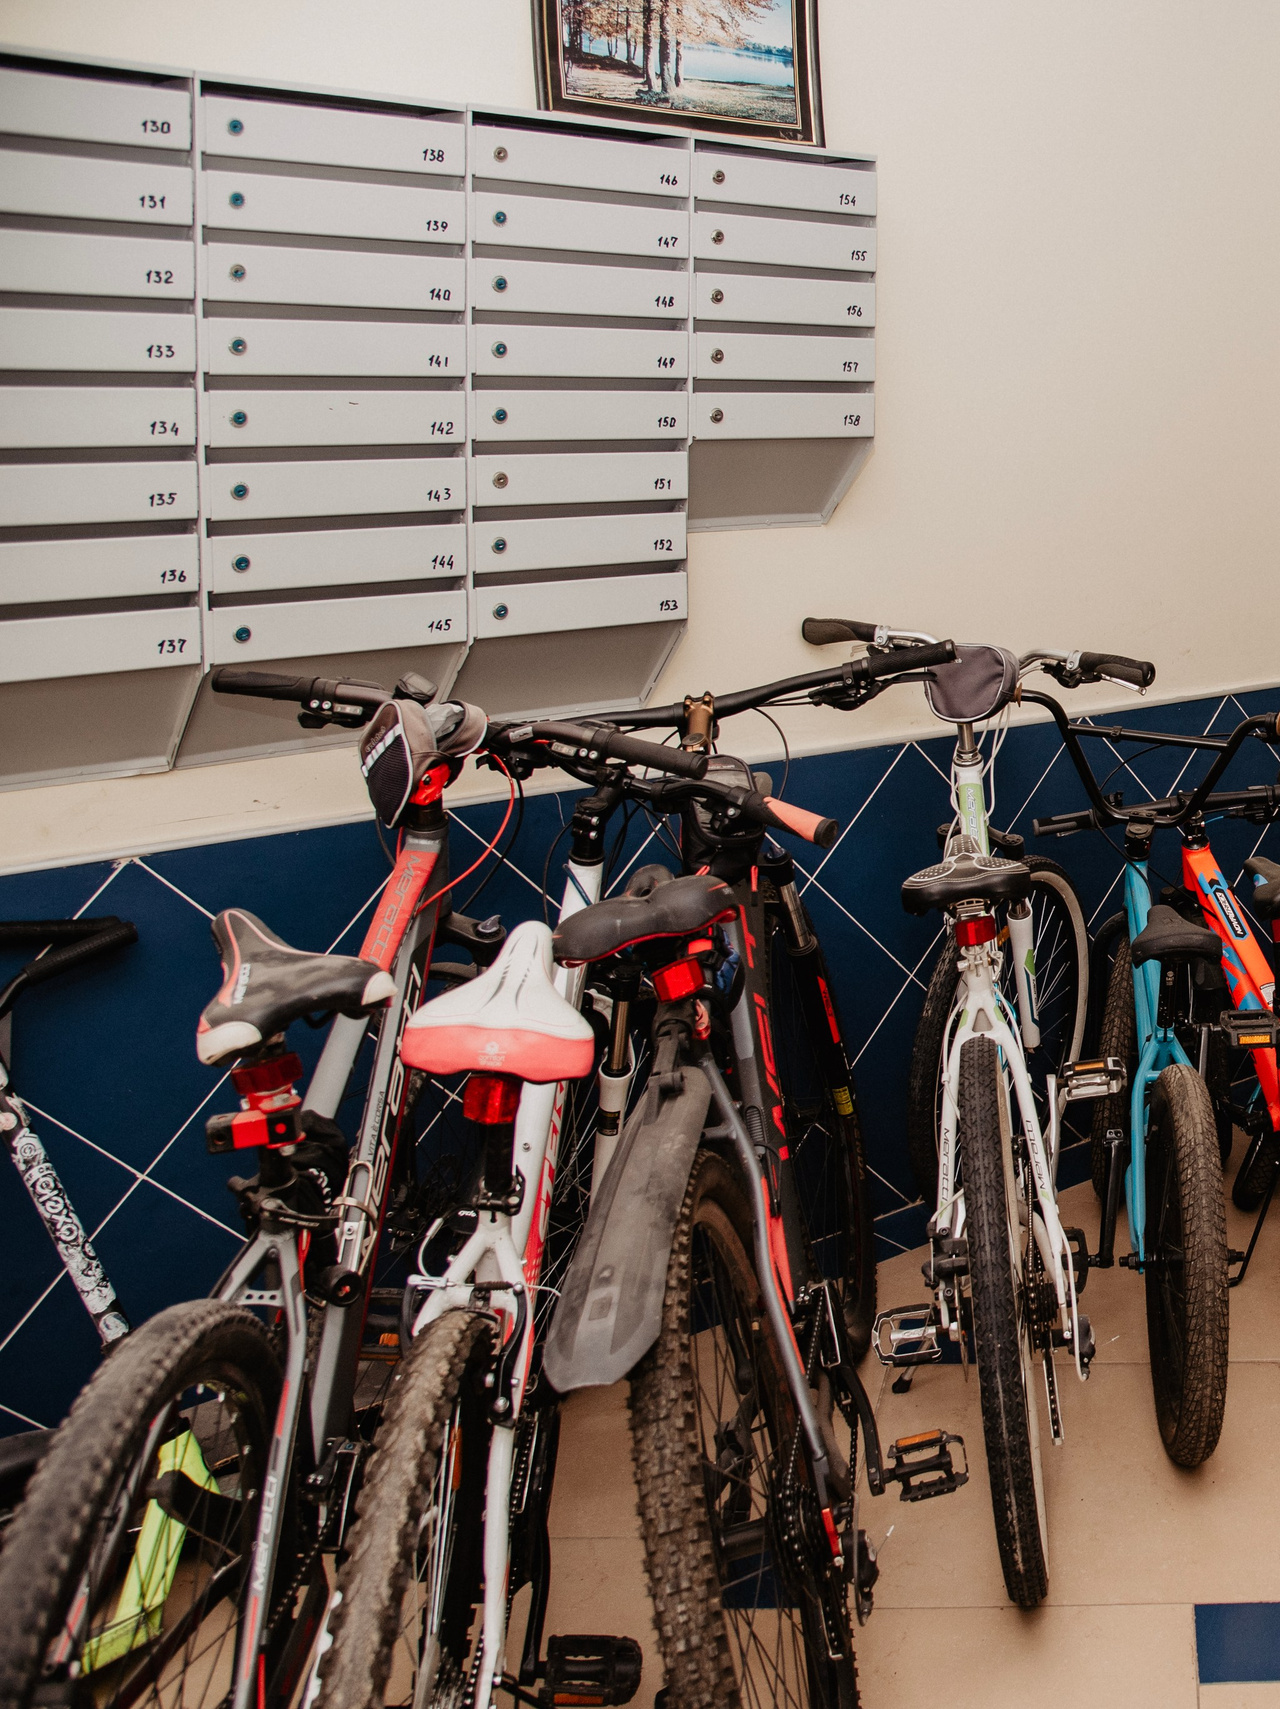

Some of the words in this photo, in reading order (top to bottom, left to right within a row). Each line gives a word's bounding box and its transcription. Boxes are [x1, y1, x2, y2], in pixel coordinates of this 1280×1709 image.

[141, 119, 171, 135] 130
[422, 148, 445, 163] 138
[659, 173, 679, 186] 146
[138, 194, 166, 210] 131
[839, 193, 857, 207] 154
[425, 219, 449, 233] 139
[657, 235, 679, 249] 147
[851, 249, 868, 262] 155
[145, 269, 174, 285] 132
[429, 287, 452, 302] 140
[654, 295, 675, 309] 148
[846, 304, 863, 318] 156
[146, 344, 176, 359] 133
[428, 354, 449, 368] 141
[657, 356, 676, 369] 149
[842, 360, 859, 373] 157
[657, 415, 677, 429] 150
[843, 414, 861, 427] 158
[149, 420, 179, 437] 134
[430, 421, 454, 436] 142
[653, 477, 672, 490] 151
[148, 492, 178, 508] 135
[426, 487, 452, 503] 143
[653, 538, 673, 552] 152
[431, 554, 454, 571] 144
[160, 568, 187, 585] 136
[659, 599, 679, 612] 153
[427, 618, 453, 633] 145
[157, 638, 188, 655] 137
[368, 855, 420, 963] Meratti
[1026, 1120, 1045, 1190] Meratti
[940, 1127, 950, 1202] Meratti
[252, 1476, 278, 1591] Meratti
